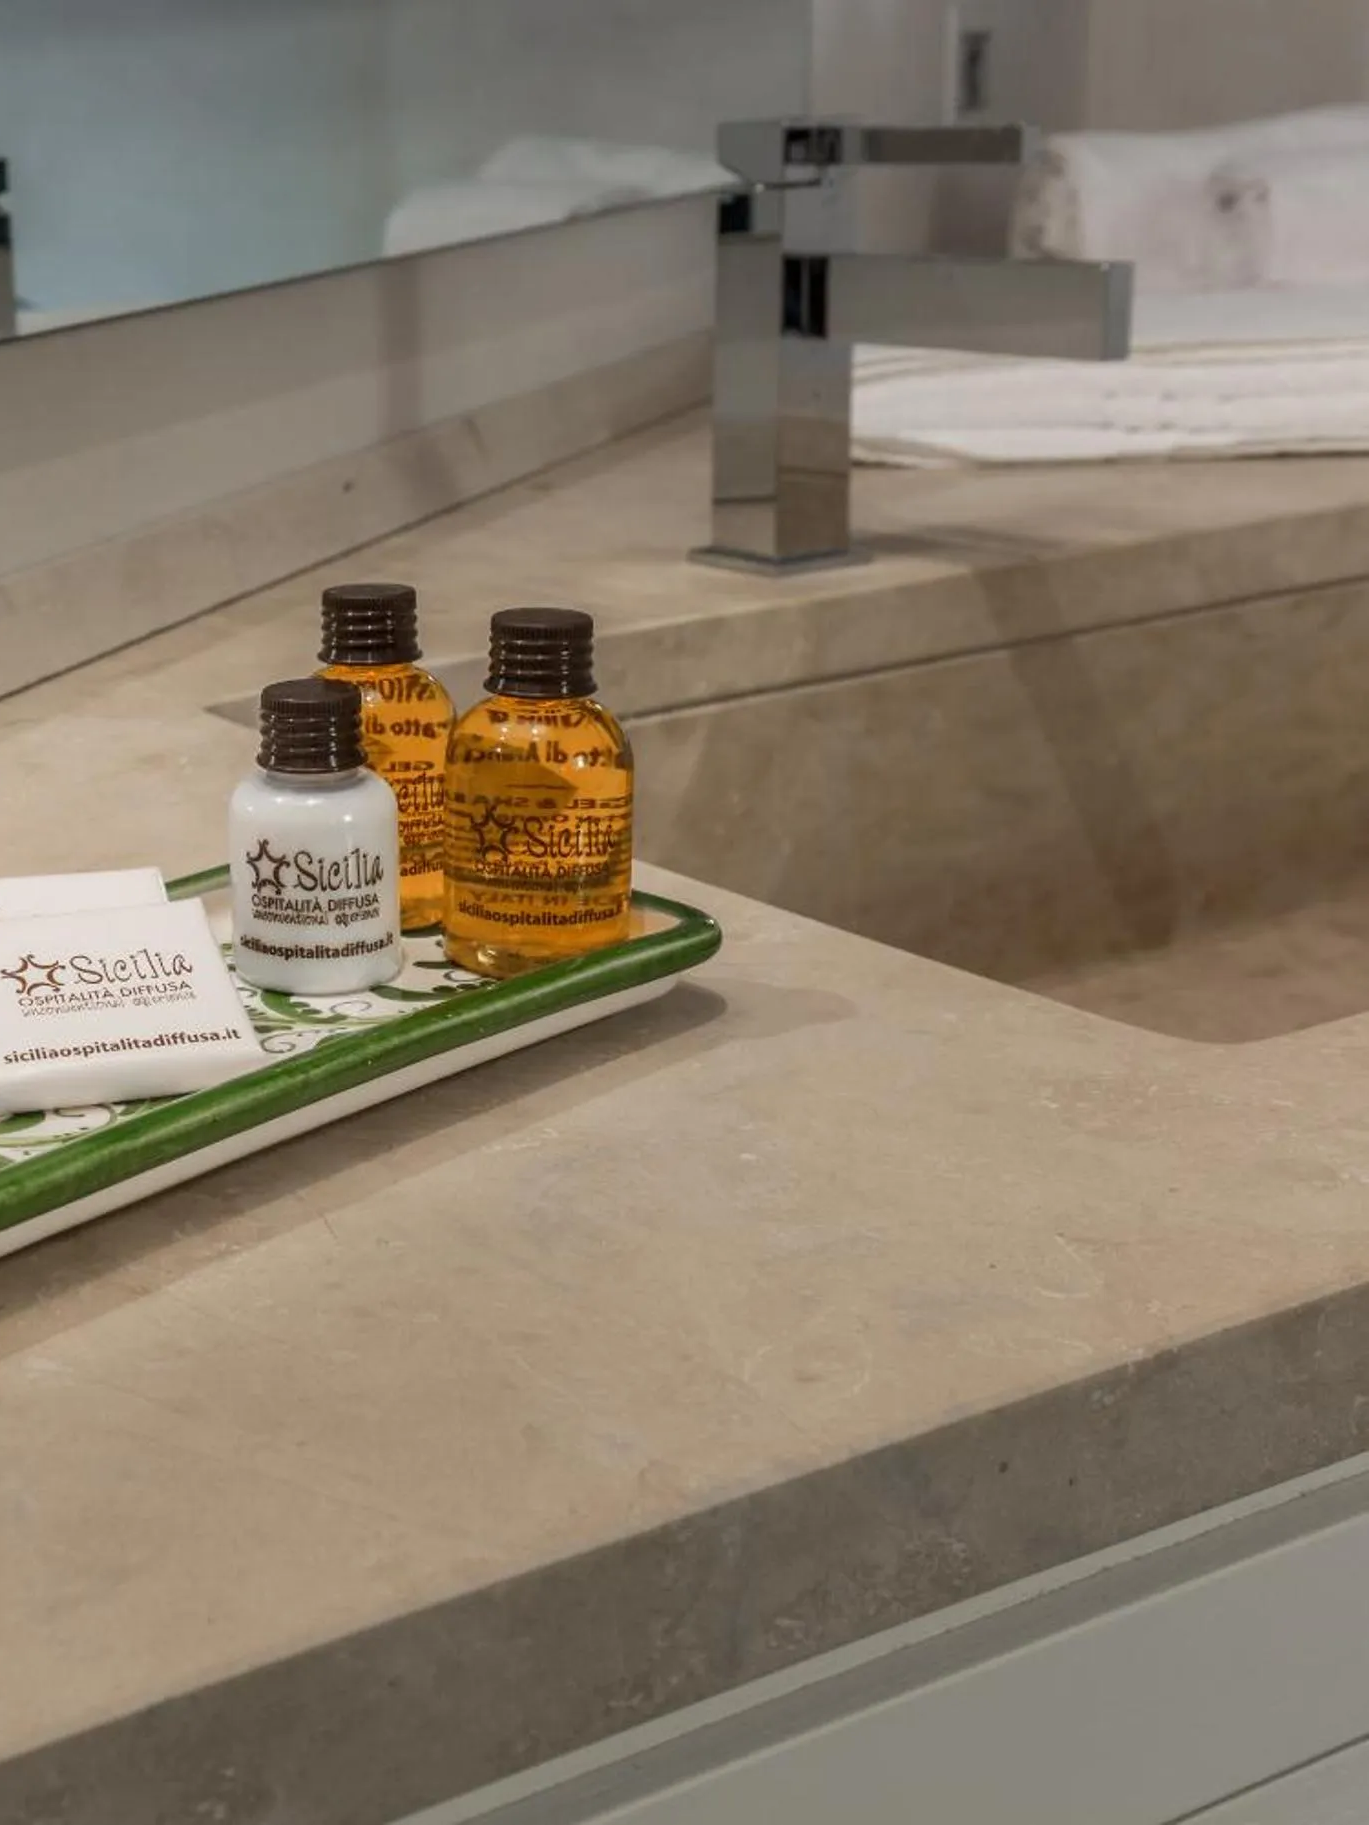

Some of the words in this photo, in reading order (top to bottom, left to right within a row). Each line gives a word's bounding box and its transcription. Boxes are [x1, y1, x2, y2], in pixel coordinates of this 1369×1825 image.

[294, 848, 384, 892] Sicilia
[252, 893, 323, 912] OSPITALITÀ
[328, 893, 379, 912] DIFFUSA
[69, 948, 193, 985] Sicilia
[18, 987, 115, 1008] OSPITALITÀ
[120, 980, 192, 998] DIFFUSA
[3, 1028, 241, 1065] siciliaospitalitadiffusa.it
